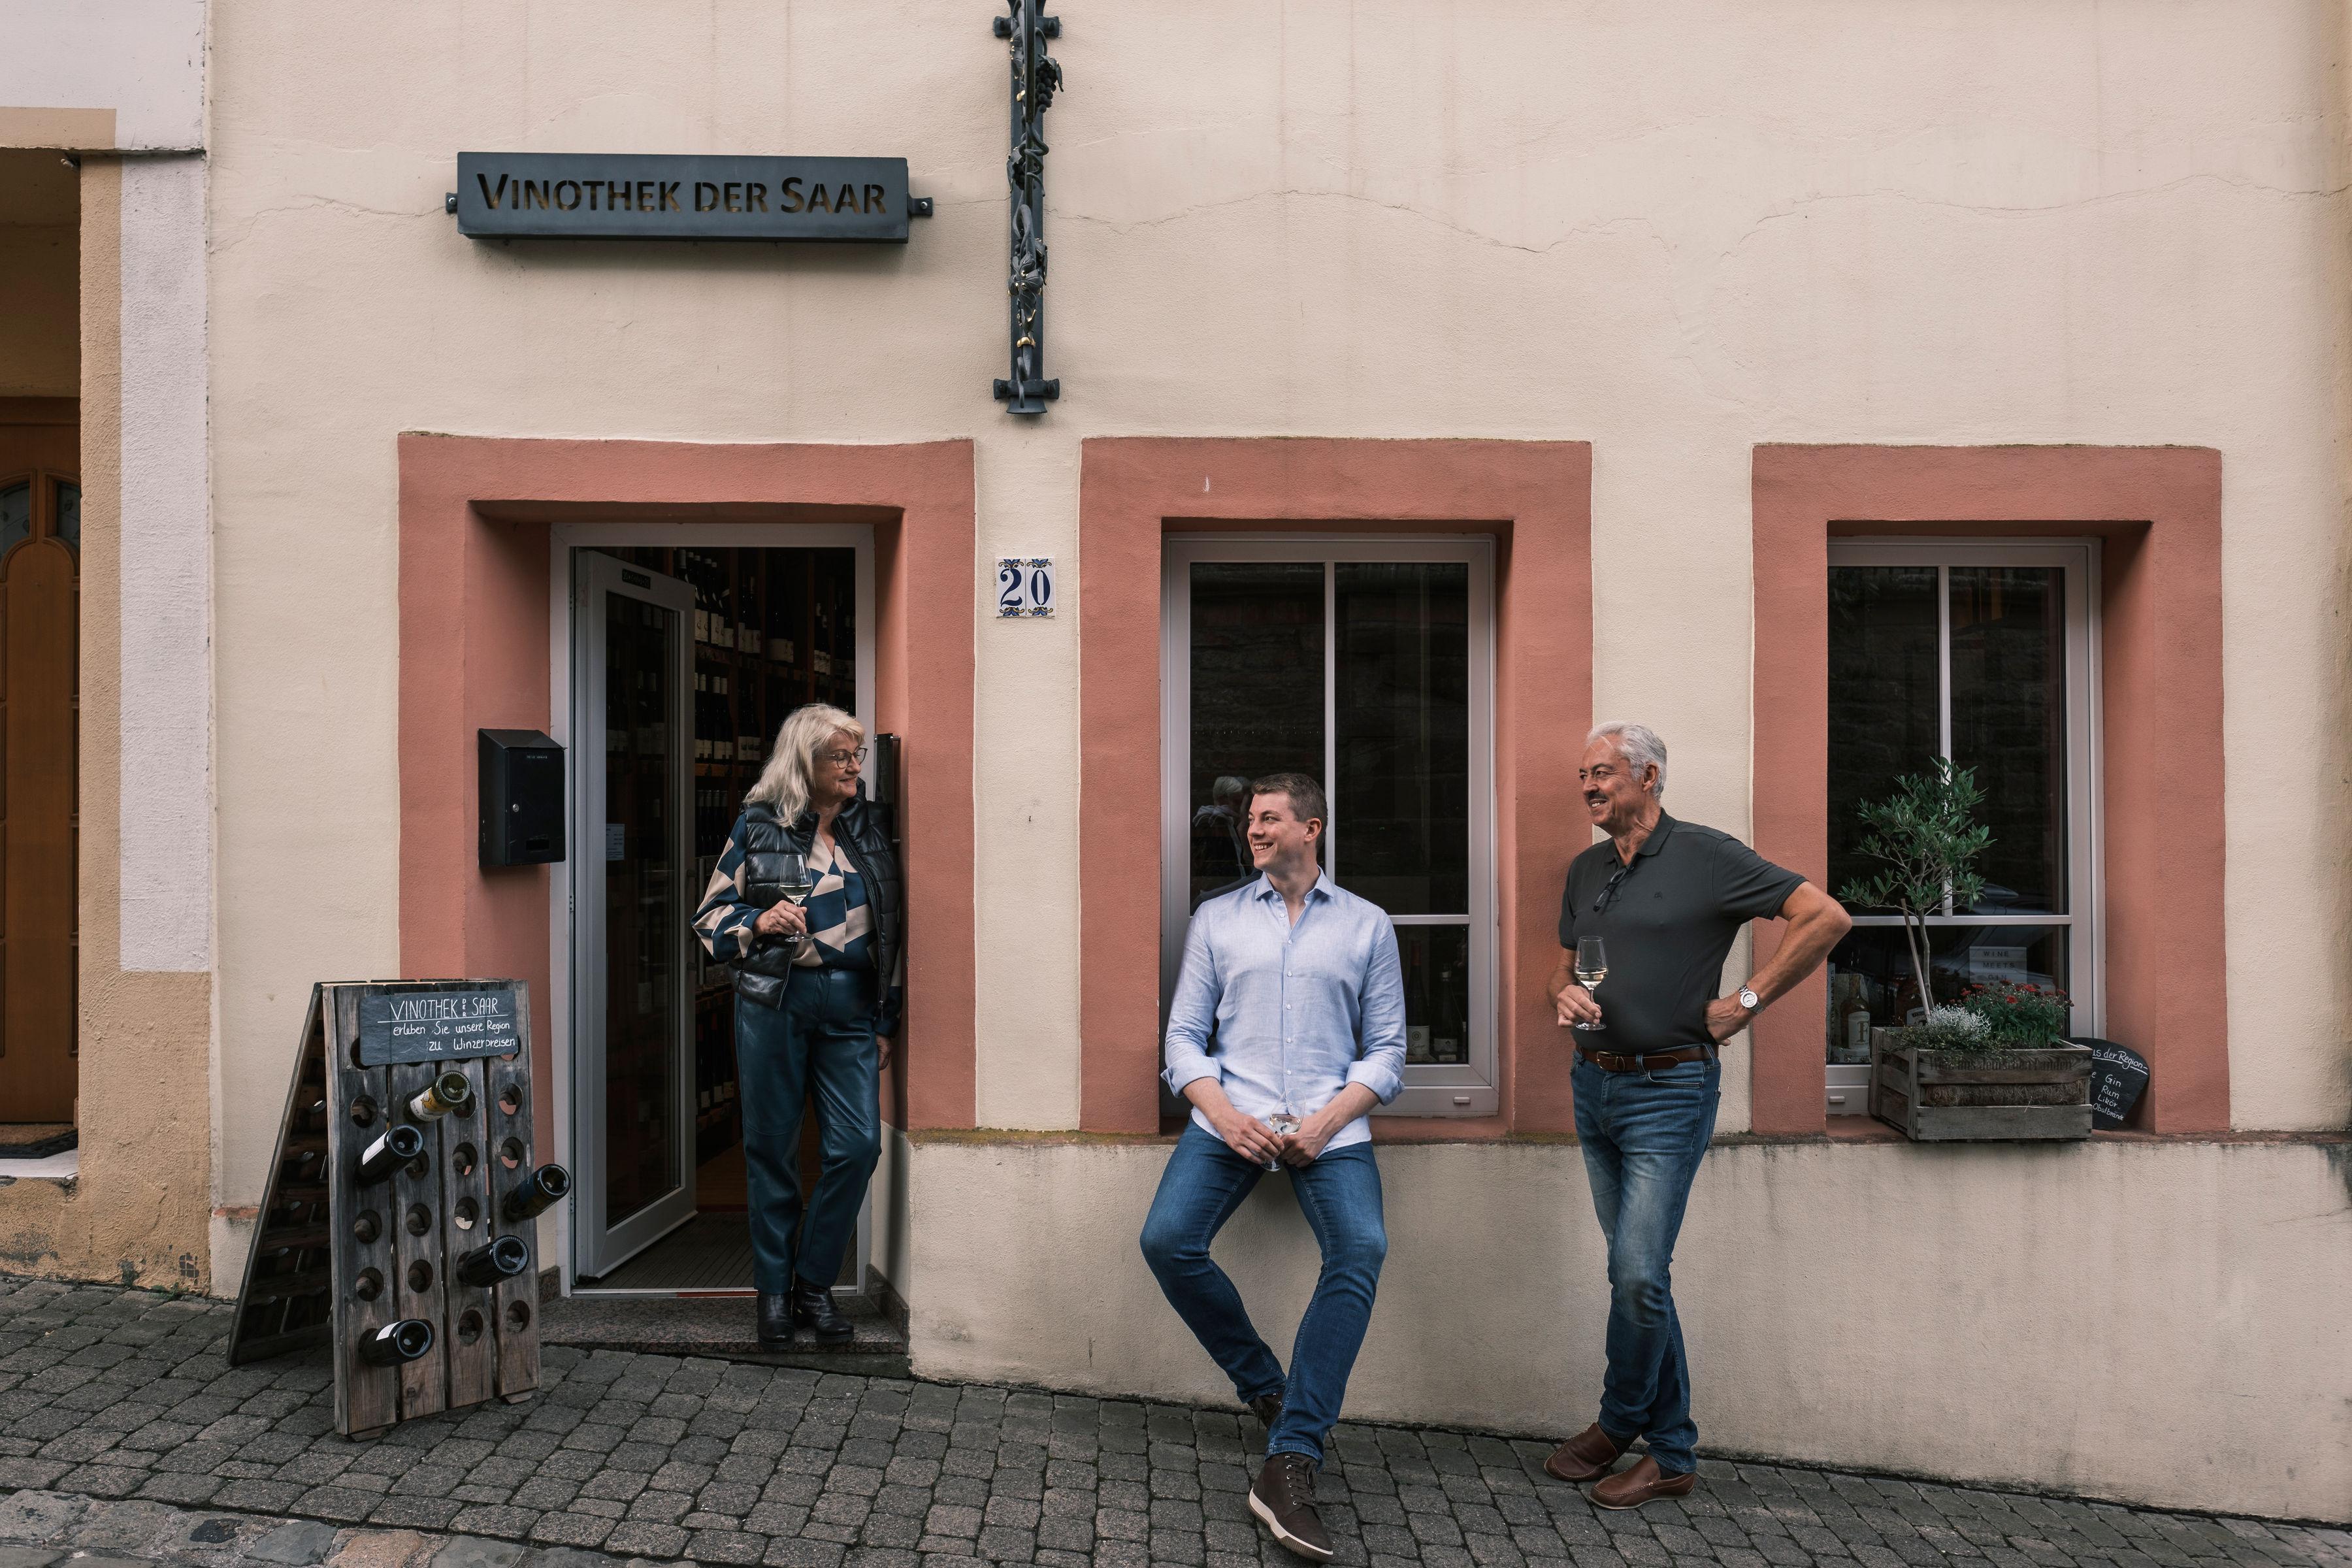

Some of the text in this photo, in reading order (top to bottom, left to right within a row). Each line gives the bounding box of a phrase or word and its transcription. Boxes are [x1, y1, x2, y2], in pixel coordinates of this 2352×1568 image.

[476, 173, 887, 215] VINOTHEK DER SAAR
[1000, 568, 1051, 607] 20
[389, 999, 459, 1021] VINOTHEK
[472, 997, 498, 1016] SAAR
[393, 1020, 510, 1036] erleben Sie unsere Region
[429, 1037, 515, 1051] zu Winzerpreisen
[2103, 1047, 2117, 1059] der
[2105, 1074, 2121, 1087] Gin
[2101, 1085, 2119, 1099] Rum
[2097, 1094, 2117, 1107] Likör
